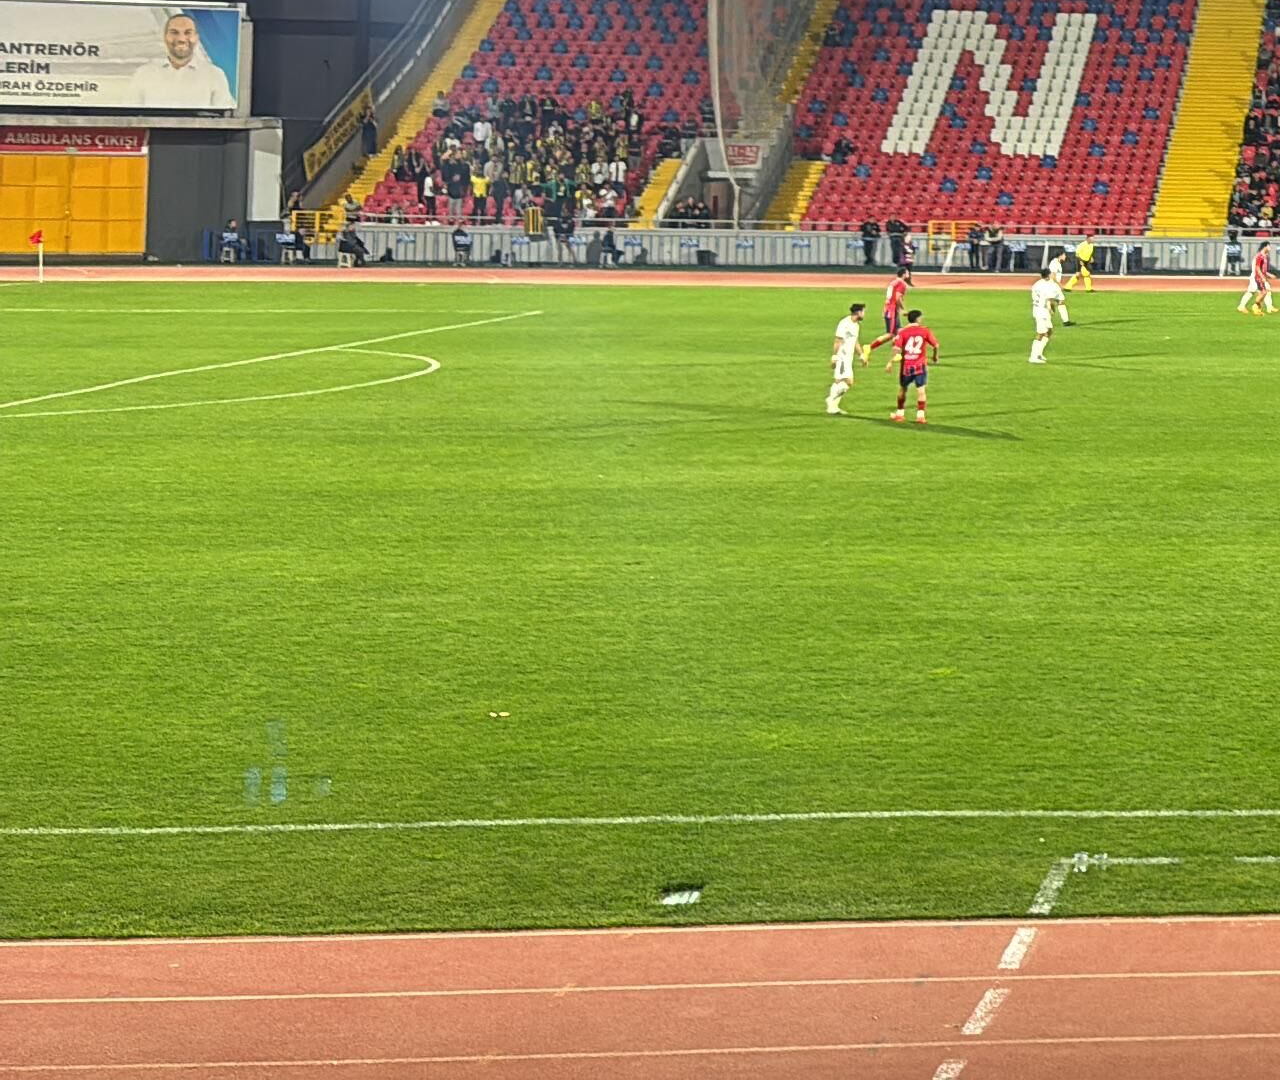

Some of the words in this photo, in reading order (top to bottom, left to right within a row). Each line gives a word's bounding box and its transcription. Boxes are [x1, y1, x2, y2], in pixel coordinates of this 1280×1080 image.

[0, 80, 31, 90] RAH
[35, 79, 99, 93] ÖZDEMİR
[5, 132, 92, 146] AMBULANS
[94, 134, 138, 150] ÇIKIŞI
[904, 335, 924, 354] 42
